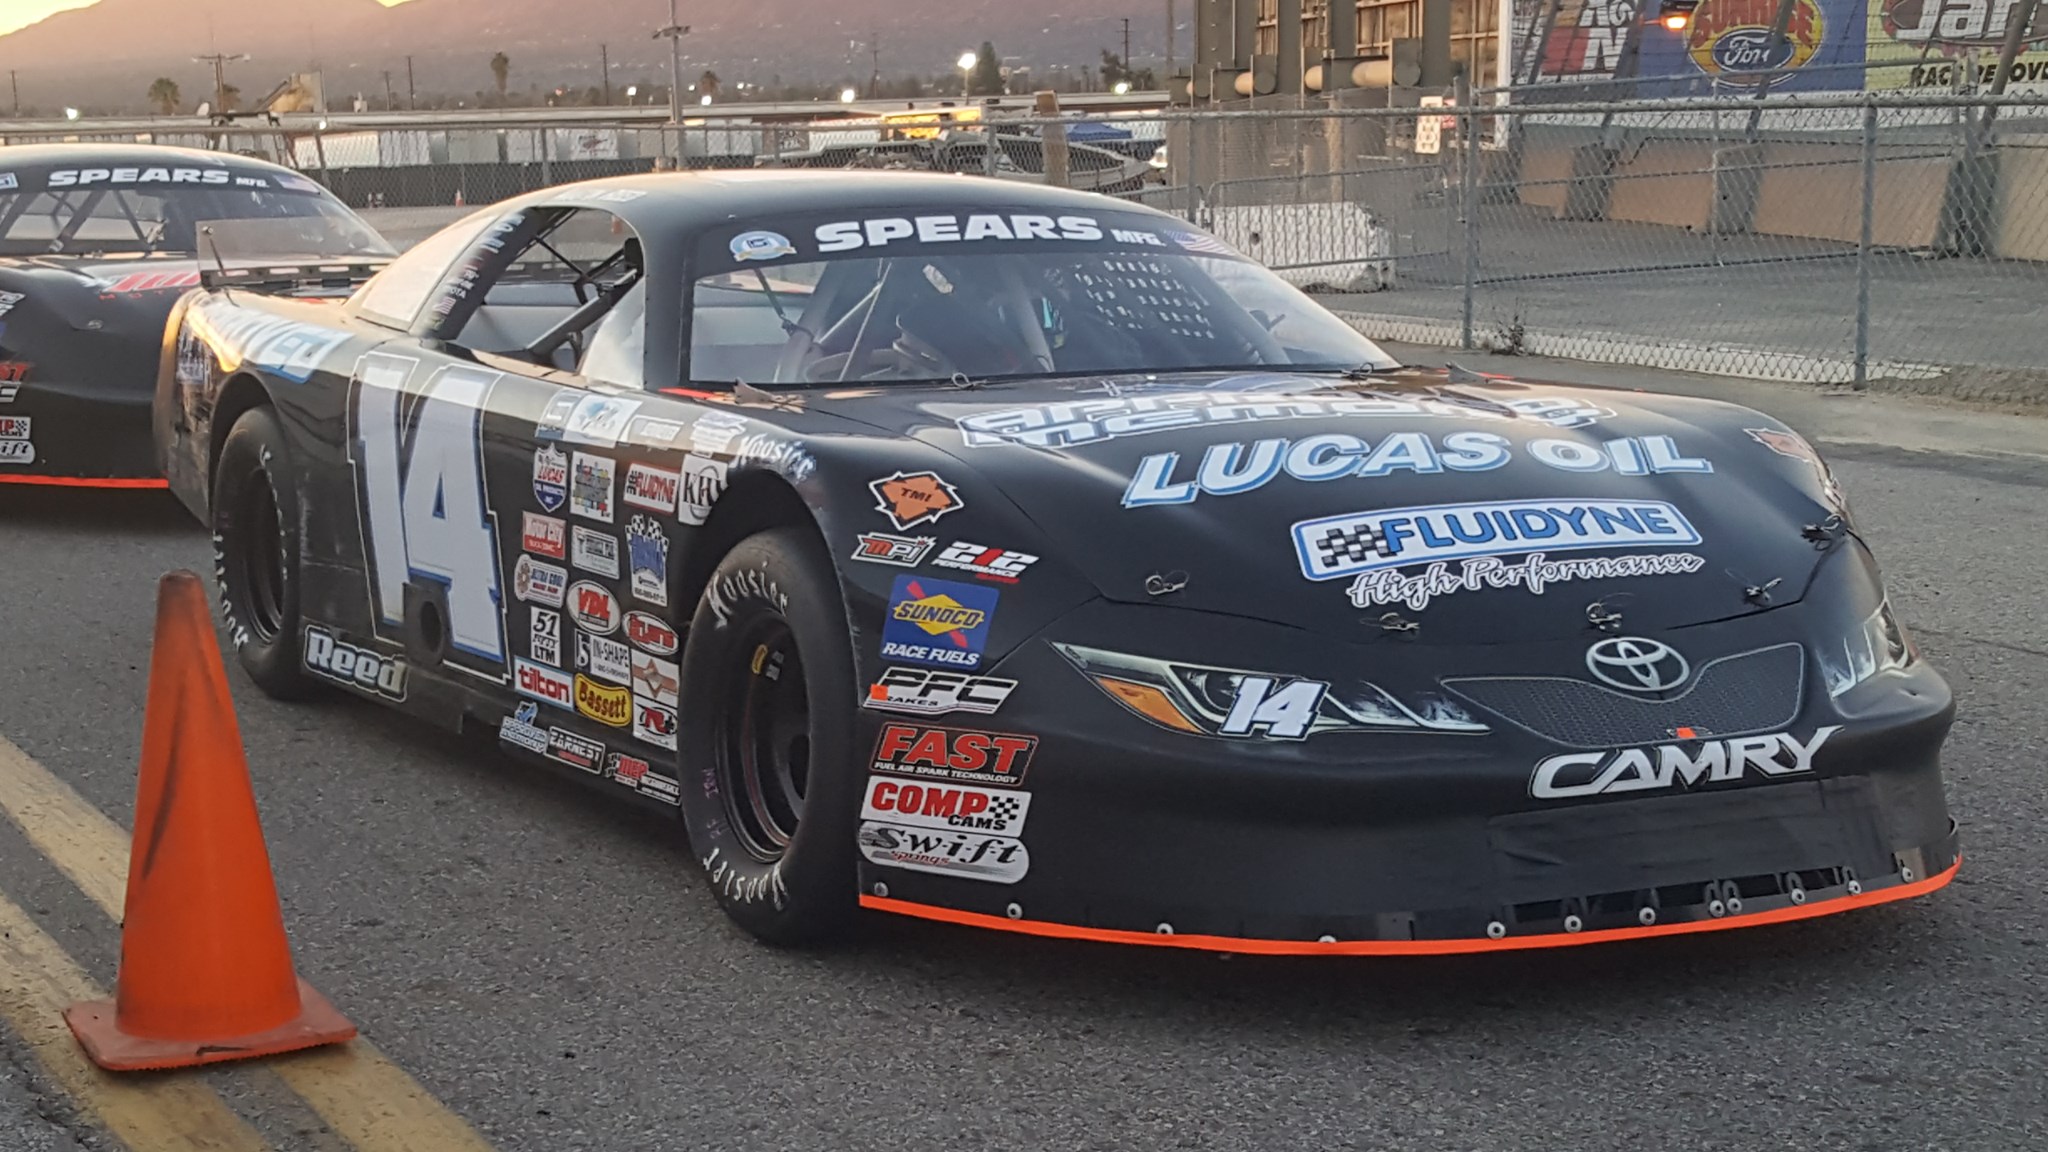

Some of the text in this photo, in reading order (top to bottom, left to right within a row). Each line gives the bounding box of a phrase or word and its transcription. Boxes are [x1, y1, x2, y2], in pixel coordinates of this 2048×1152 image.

[1910, 65, 1964, 88] RAC
[48, 168, 271, 188] SPEARS MFG.
[814, 214, 1104, 253] SPEARS
[1111, 228, 1168, 248] MFG.
[536, 467, 565, 484] LUCAS
[1120, 431, 1714, 509] LUCAS OIL
[901, 487, 933, 502] TMI
[348, 353, 510, 682] 14
[1381, 506, 1677, 553] FLUIDYNE
[931, 559, 1019, 578] PERFORMANCE
[937, 541, 1040, 572] 212
[706, 560, 789, 631] Hoosier
[1346, 552, 1706, 610] High Performance
[532, 611, 559, 638] 51
[896, 602, 984, 627] SUNOCO
[305, 625, 407, 701] Reed
[534, 645, 557, 666] LTM
[882, 642, 980, 666] RACE FUELS
[517, 664, 571, 704] tilton
[879, 668, 1016, 706] PFC
[578, 683, 628, 719] Bassett
[880, 695, 939, 707] RAKES
[1217, 674, 1331, 742] 14
[878, 725, 1030, 775] FAST
[1527, 724, 1846, 800] CAMRY
[874, 762, 1019, 784] FUEL AIR SPARK TECHNOLOGY
[870, 781, 990, 819] COMP
[947, 813, 1008, 832] CAMS
[890, 849, 951, 866] springs
